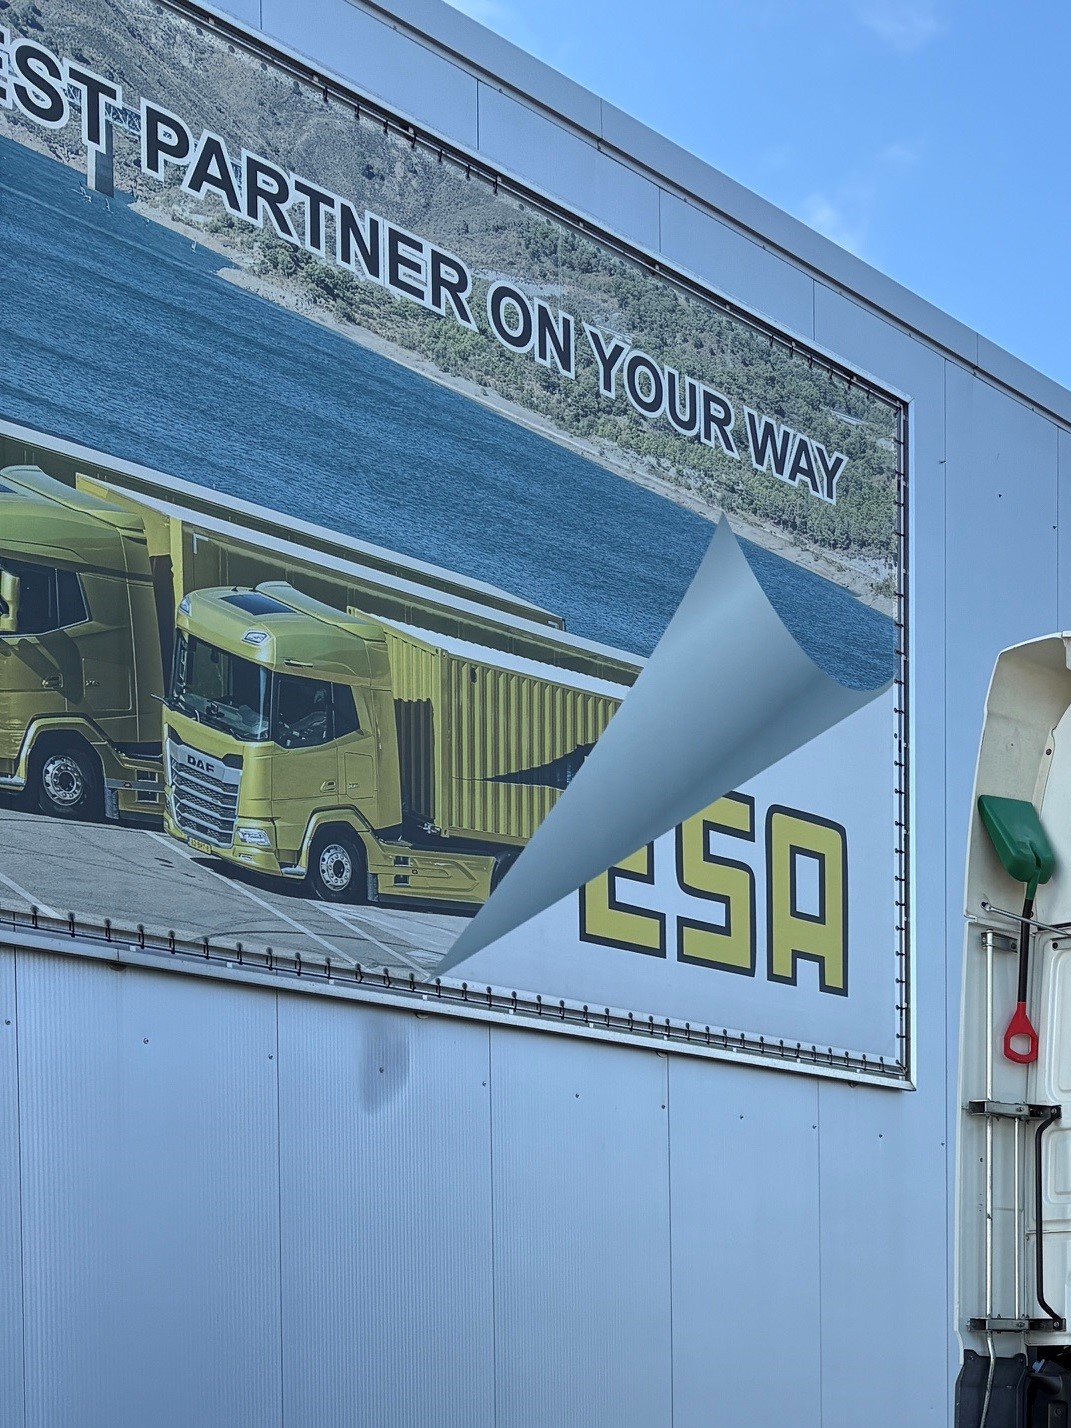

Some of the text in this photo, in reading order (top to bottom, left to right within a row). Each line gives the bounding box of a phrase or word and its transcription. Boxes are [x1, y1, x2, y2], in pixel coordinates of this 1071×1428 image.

[0, 30, 844, 500] ST PARTNER ON YOUR WAY
[186, 754, 215, 774] DAF
